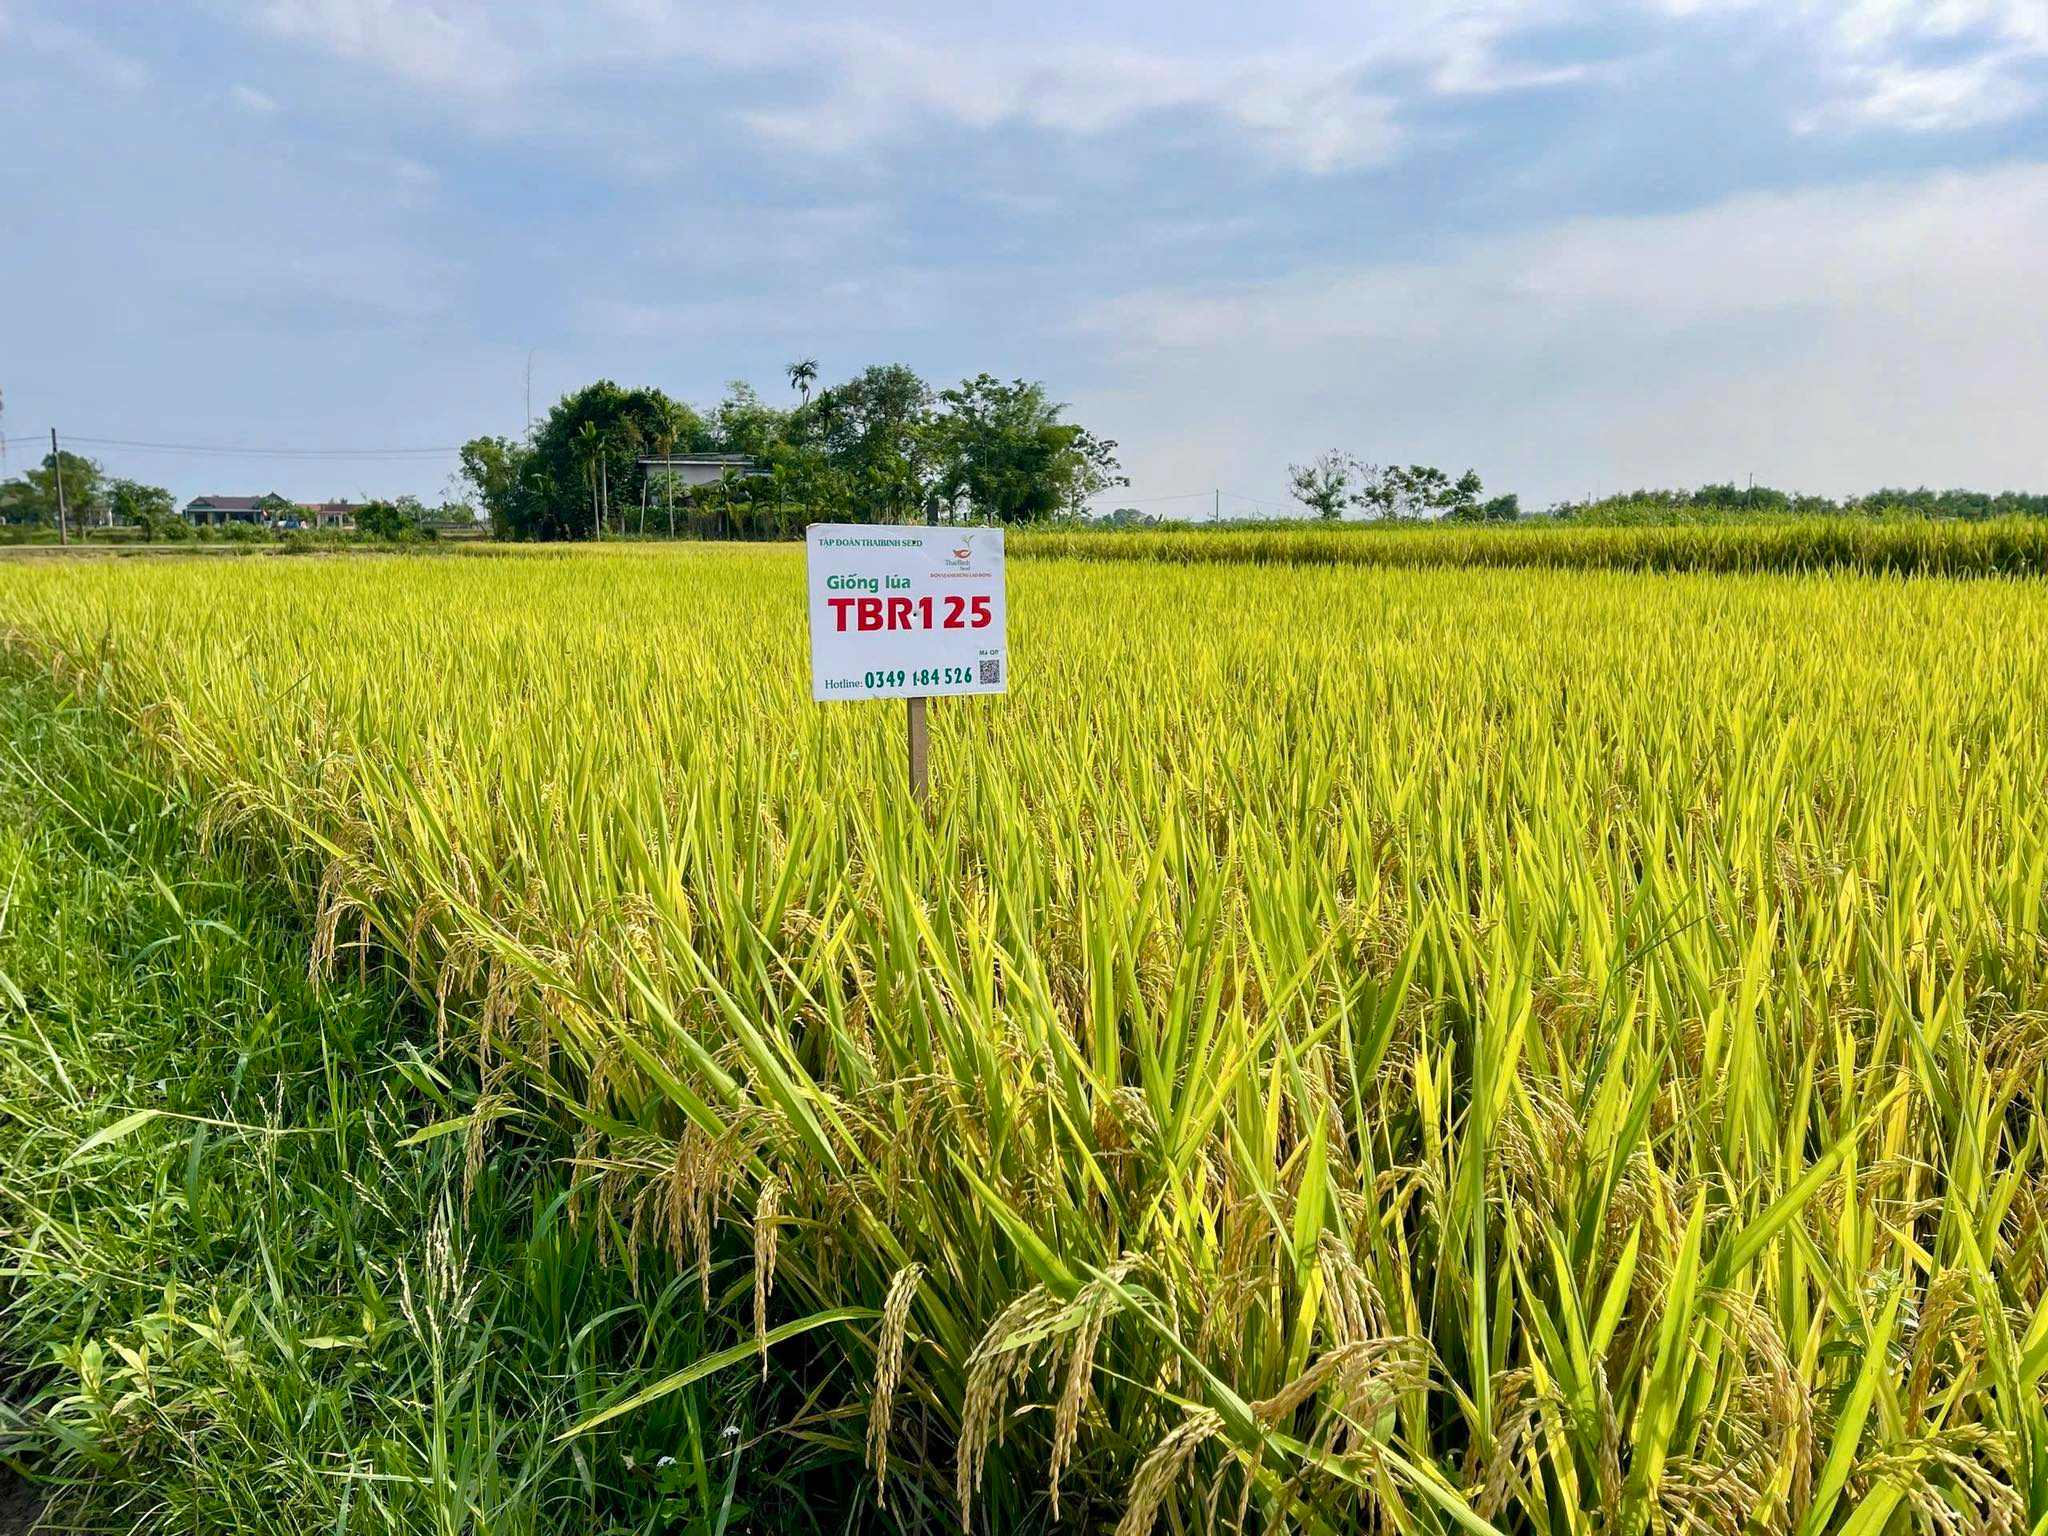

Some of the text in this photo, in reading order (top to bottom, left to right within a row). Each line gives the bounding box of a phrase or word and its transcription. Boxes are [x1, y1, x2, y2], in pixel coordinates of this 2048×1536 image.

[826, 573, 911, 593] Giống lúa
[828, 596, 992, 632] TBR125
[825, 666, 972, 690] Hotline: 0349 184 526
